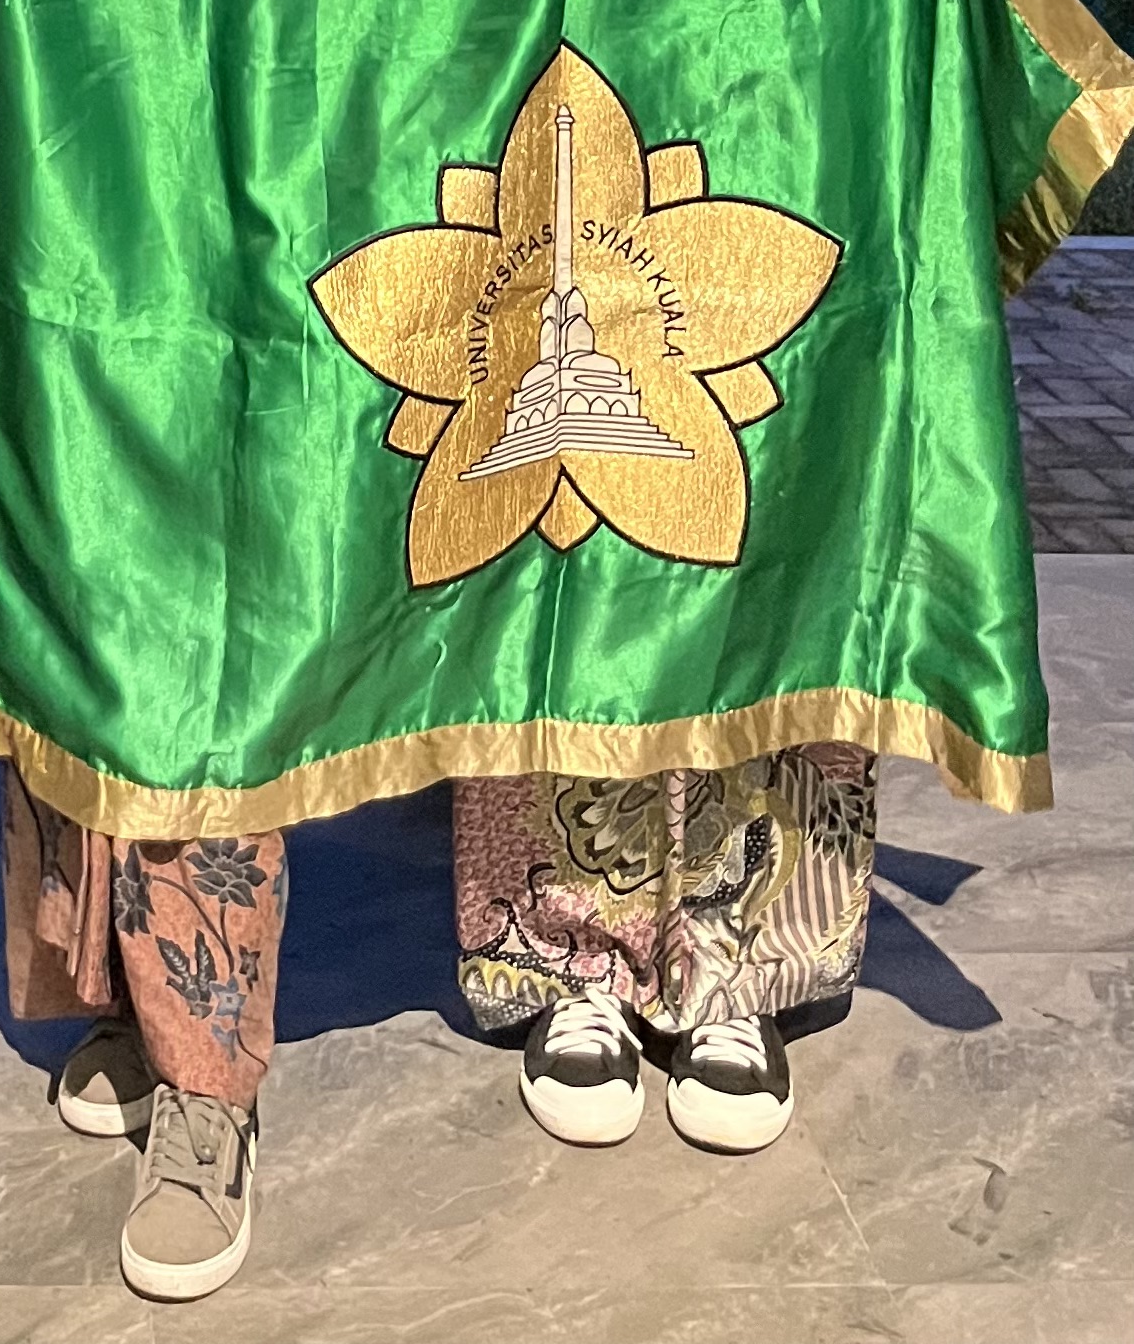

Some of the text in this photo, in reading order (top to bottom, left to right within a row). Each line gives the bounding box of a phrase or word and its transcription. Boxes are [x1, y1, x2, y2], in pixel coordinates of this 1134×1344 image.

[468, 219, 687, 385] UNIVERSITAS SYIAH KUALA
